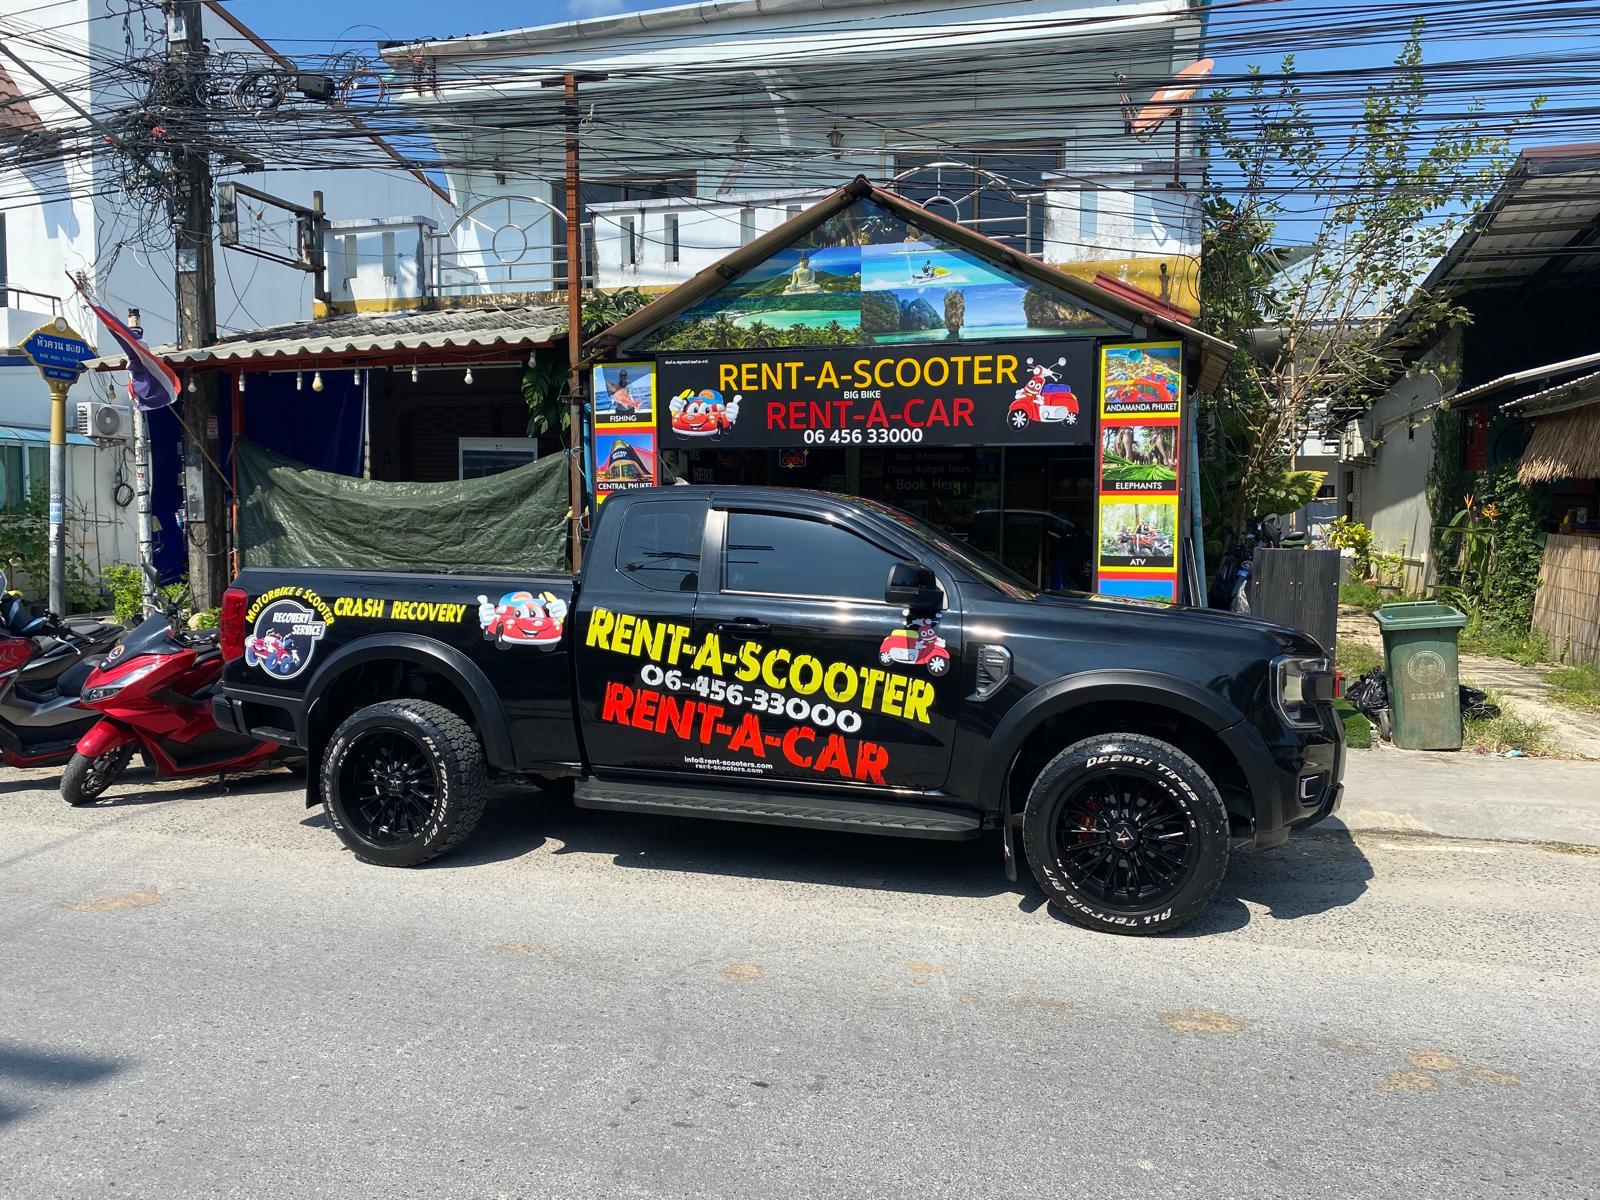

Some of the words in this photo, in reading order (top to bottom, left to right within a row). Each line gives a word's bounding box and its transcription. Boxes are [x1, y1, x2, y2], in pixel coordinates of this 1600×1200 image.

[719, 354, 1019, 392] RENT-A-SCOOTER
[843, 390, 861, 399] BIG
[862, 390, 881, 399] BIKE
[1106, 402, 1150, 411] ANDAMANDA
[1151, 402, 1178, 411] PHUKET
[609, 414, 637, 422] FISHING
[767, 398, 975, 430] RENT-A-CAR
[803, 429, 826, 444] 06
[830, 428, 862, 444] 456
[866, 428, 923, 444] 33000
[598, 482, 627, 490] CENTRAL
[627, 481, 653, 489] PHUKET
[896, 478, 928, 490] Book
[1115, 481, 1163, 490] ELEPHANTS
[1129, 558, 1147, 566] ATV
[245, 586, 295, 623] MOTORBIKE
[303, 588, 335, 626] SCOOTER
[333, 597, 385, 619] CRASH
[391, 600, 467, 624] RECOVERY
[272, 612, 310, 624] RECOVERY
[291, 624, 322, 636] SERVICE
[585, 606, 936, 725] RENT-A-SCOOTER
[640, 663, 863, 733] 06-456-33000
[601, 680, 890, 786] RENT-A-CAR
[695, 763, 763, 774] rent-scooters.com
